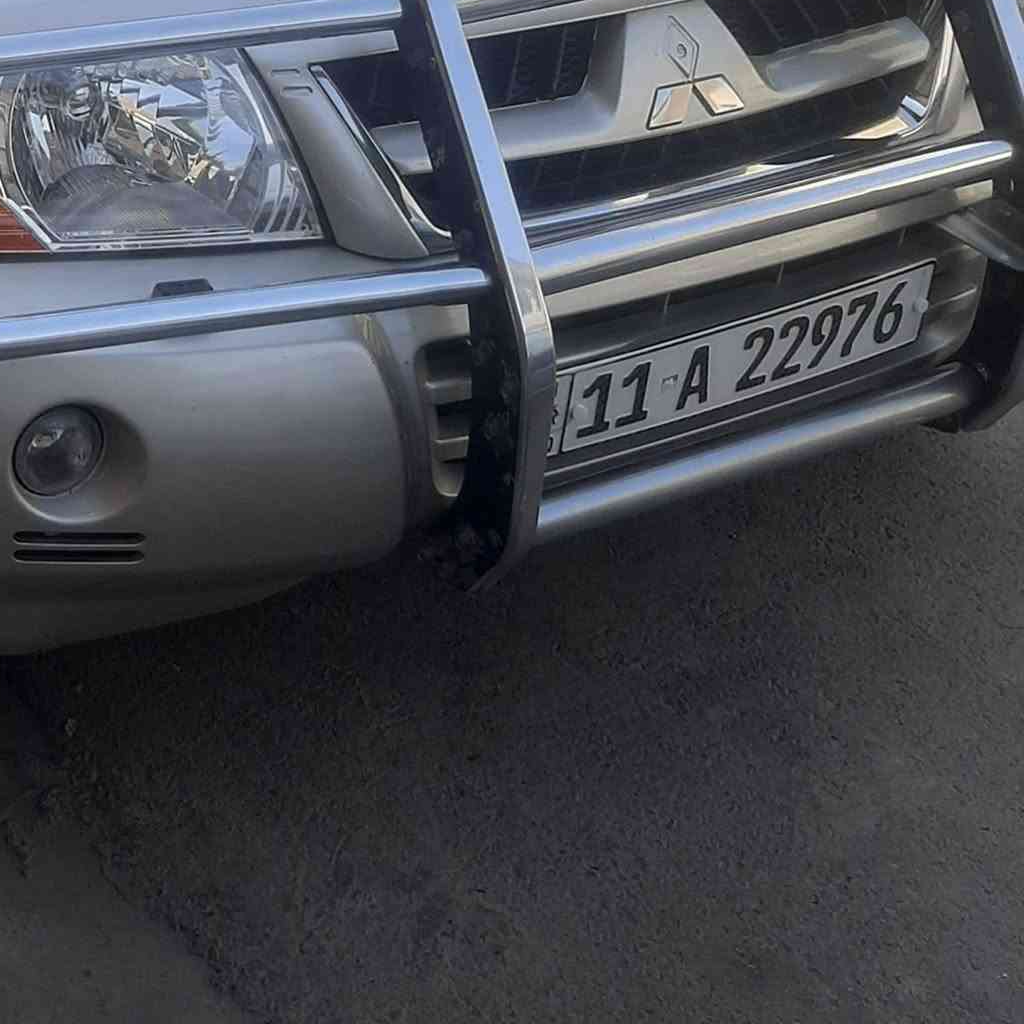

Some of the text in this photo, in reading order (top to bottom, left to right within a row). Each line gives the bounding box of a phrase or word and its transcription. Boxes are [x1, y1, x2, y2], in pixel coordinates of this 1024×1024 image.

[576, 361, 652, 438] 11
[675, 345, 711, 410] A
[734, 280, 909, 393] 22976
